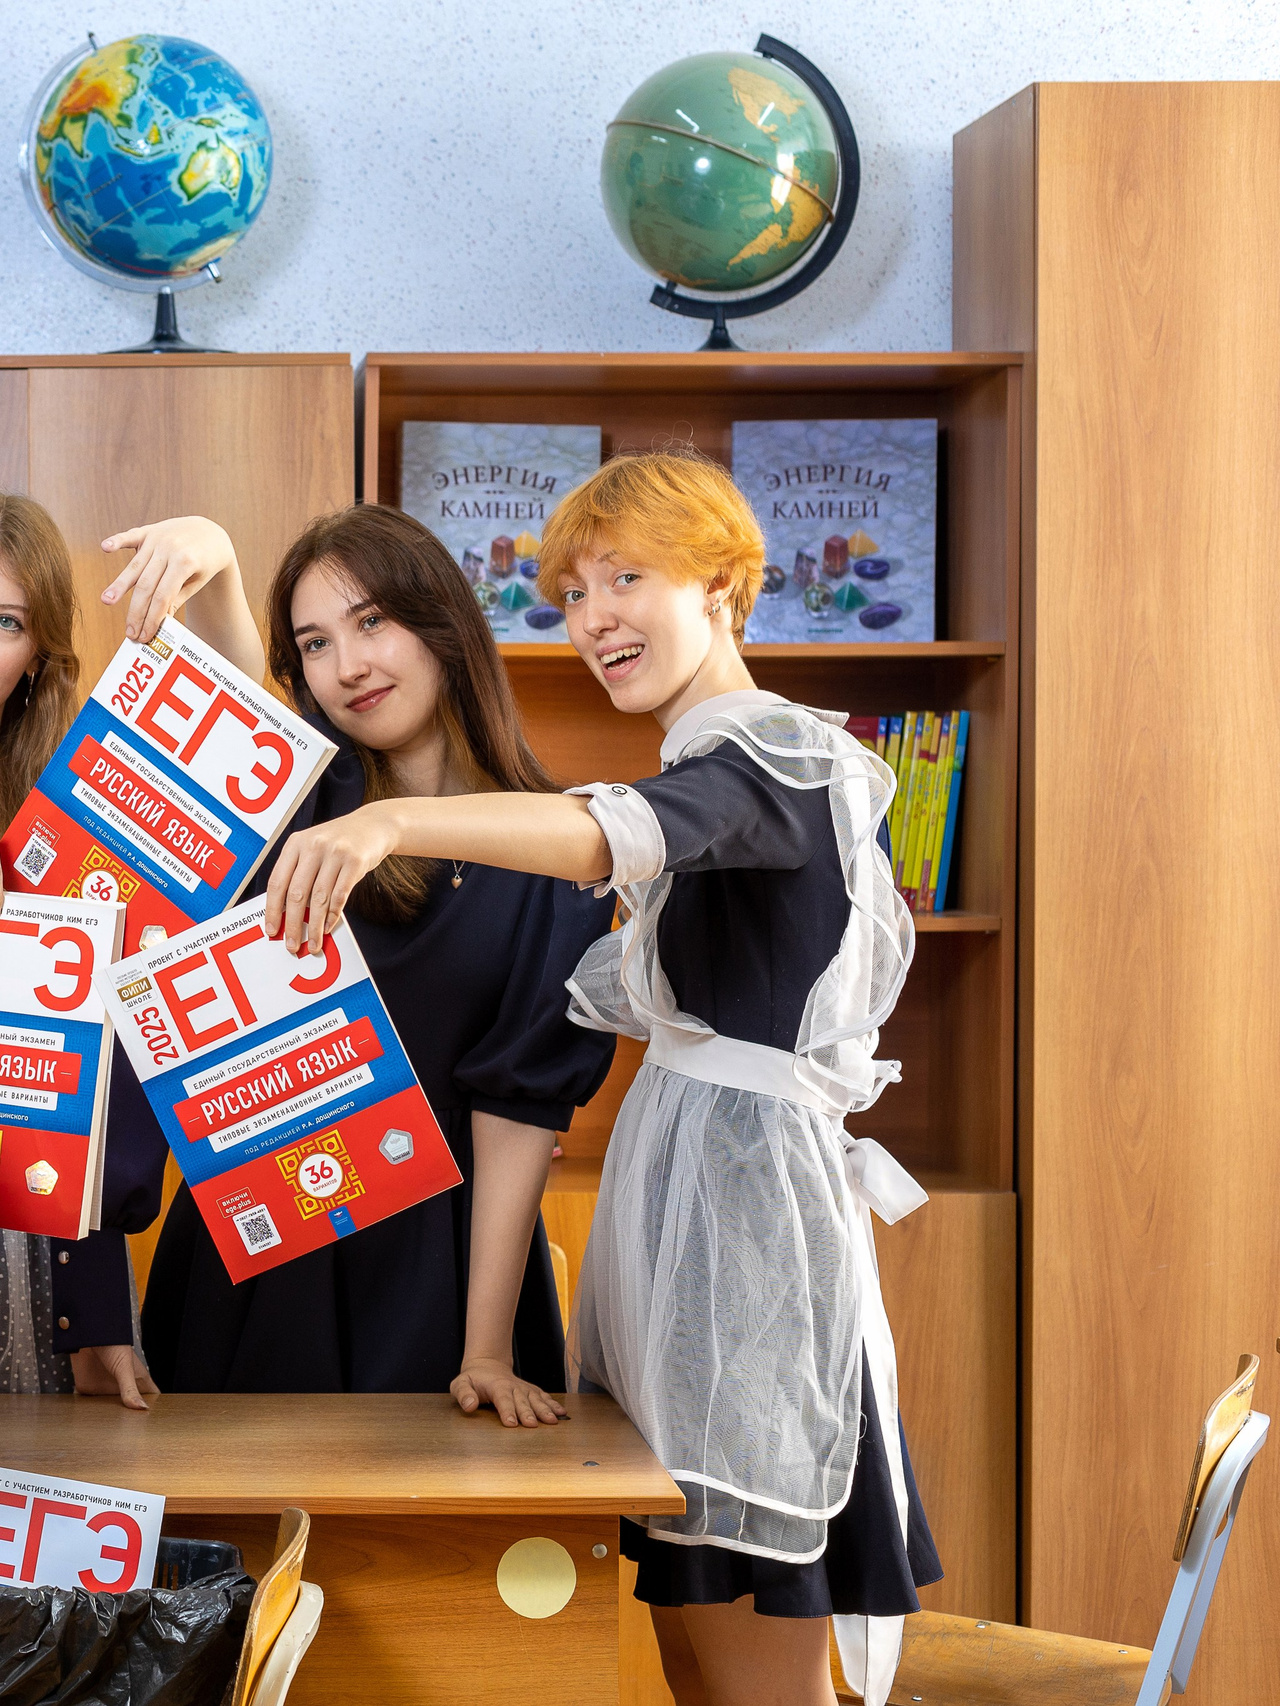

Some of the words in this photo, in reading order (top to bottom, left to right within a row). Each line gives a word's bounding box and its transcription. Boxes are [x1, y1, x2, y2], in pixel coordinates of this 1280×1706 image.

[432, 465, 557, 494] ЭНЕРГИЯ
[764, 464, 892, 492] ЭНЕРГИЯ
[441, 498, 544, 520] КАМНЕЙ
[773, 495, 879, 520] КАМНЕЙ
[141, 646, 163, 665] ШКОЛЕ
[111, 657, 155, 717] 2025
[180, 644, 203, 665] ПРОЕКТ
[203, 662, 208, 670] С
[209, 667, 237, 693] УЧАСТИЕМ
[237, 690, 282, 730] РАЗРАБОТЧИКОВ
[283, 727, 296, 741] КИМ
[296, 738, 309, 751] ЕГЭ
[134, 654, 294, 814] ЕГЭ
[109, 741, 136, 765] ЕДИНЫЙ
[136, 762, 194, 813] ГОСУДАРСТВЕННЫЙ
[194, 809, 223, 836] ЭКЗАМЕН
[89, 757, 166, 828] РУССКИЙ
[162, 818, 215, 869] ЯЗЫК
[80, 787, 107, 812] ТИПОВЫЕ
[107, 809, 161, 858] ЭКЗАМЕНАЦИОННЫЕ
[162, 855, 193, 883] ВАРИАНТЫ
[83, 815, 95, 828] ПОД
[95, 824, 128, 855] РЕДАКЦИЕЙ
[137, 860, 169, 888] ДОЩИНСКОГО
[90, 875, 113, 901] 36
[6, 908, 64, 923] РАЗРАБОТЧИКОВ
[67, 915, 83, 924] КИМ
[85, 917, 99, 927] ЕГЭ
[148, 952, 175, 970] ПРОЕКТ
[176, 948, 182, 956] С
[183, 931, 221, 953] УЧАСТИЕМ
[221, 908, 266, 934] РАЗРАБОТЧИ
[121, 980, 149, 998] ФИПИ
[126, 992, 152, 1008] ШКОЛЕ
[20, 1035, 56, 1046] ЭКЗАМЕН
[133, 1006, 180, 1066] 2025
[193, 1069, 226, 1090] ЕДИНЫЙ
[227, 1035, 301, 1075] ГОСУДАРСТВЕННЫЙ
[303, 1018, 339, 1043] ЭКЗАМЕН
[200, 1062, 294, 1126] РУССКИЙ
[296, 1035, 359, 1082] ЯЗЫК
[11, 1092, 49, 1104] ВАРИАНТЫ
[218, 1123, 251, 1144] ТИПОВЫЕ
[252, 1091, 323, 1129] ЭКЗАМЕНАЦИОННЫЕ
[325, 1072, 364, 1095] ВАРИАНТЫ
[244, 1144, 260, 1155] ПОД
[260, 1125, 301, 1148] РЕДАКЦИЕЙ
[315, 1100, 356, 1123] ДОЩИНСКОГО
[305, 1160, 334, 1185] 36
[312, 1178, 338, 1193] ВАРИАНТОВ
[221, 1192, 248, 1207] включи
[225, 1199, 252, 1214] ege.plus
[4, 1480, 10, 1488] С
[12, 1481, 50, 1496] УЧАСТИЕМ
[53, 1488, 113, 1506] РАЗРАБОТЧИКОВ
[115, 1500, 132, 1510] КИМ
[134, 1503, 148, 1513] ЕГЭ
